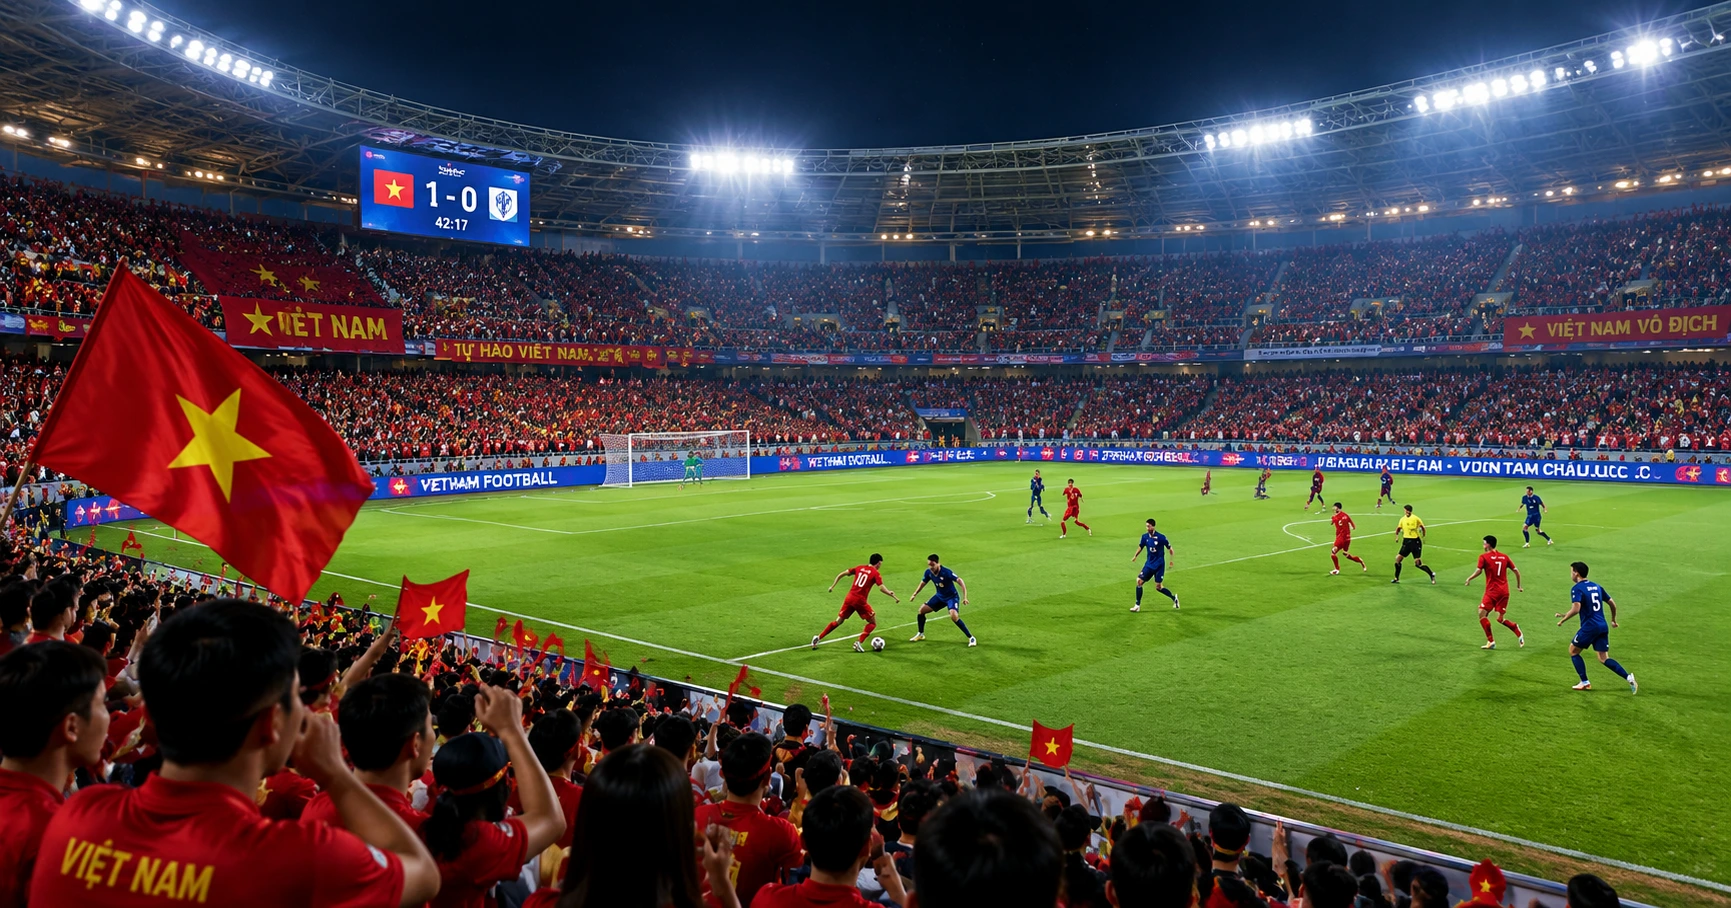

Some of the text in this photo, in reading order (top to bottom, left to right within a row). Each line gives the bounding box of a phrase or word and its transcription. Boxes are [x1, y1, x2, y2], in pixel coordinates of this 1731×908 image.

[426, 181, 438, 208] 1
[461, 186, 477, 213] 0
[435, 216, 468, 231] 42:17
[330, 314, 388, 340] NAM
[1547, 313, 1718, 340] VIỆT NAM VÔ ĐỊCH
[453, 343, 475, 361] TỰ
[1503, 462, 1539, 475] TAM
[483, 472, 557, 488] FOOTBALL
[1495, 561, 1502, 576] 7
[855, 572, 868, 587] 10
[1591, 593, 1601, 611] 5
[61, 837, 215, 903] VIỆT NAM
